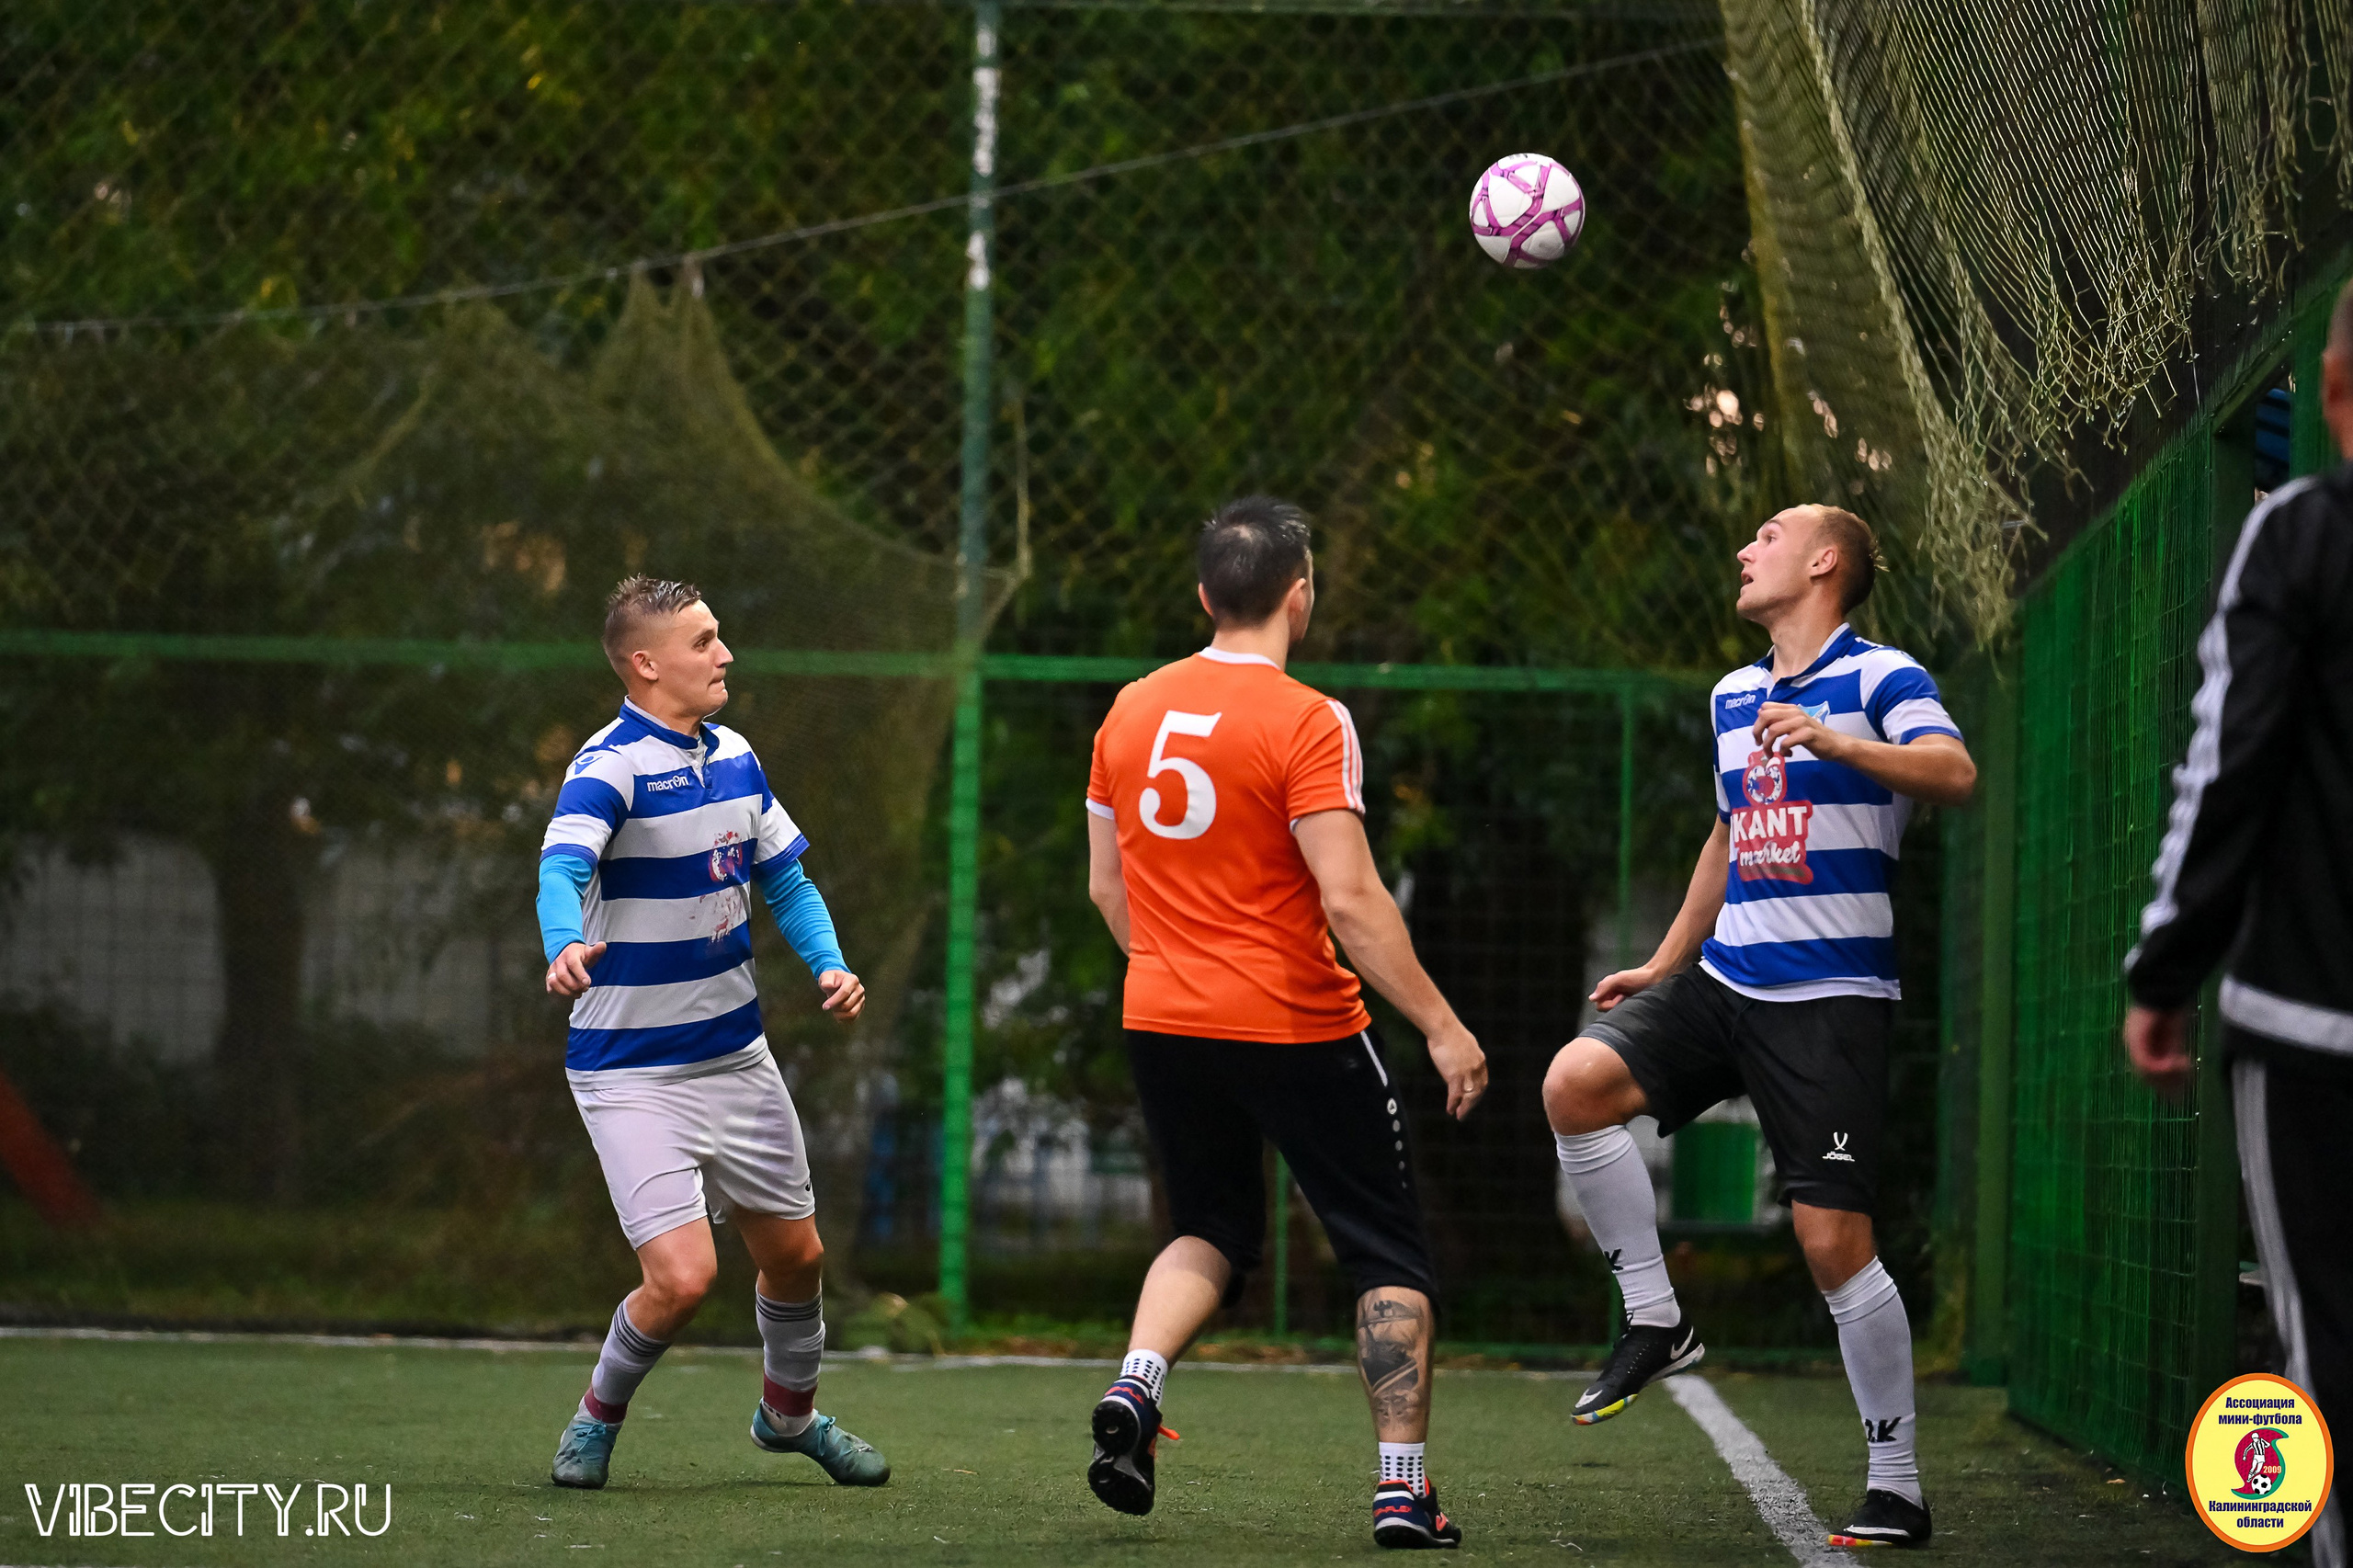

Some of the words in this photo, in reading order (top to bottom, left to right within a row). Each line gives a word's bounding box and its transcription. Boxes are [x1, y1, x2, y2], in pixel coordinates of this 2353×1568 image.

[1725, 694, 1756, 709] macron
[647, 775, 688, 791] macron
[1139, 710, 1222, 840] 5
[1733, 806, 1807, 843] KANT
[1740, 840, 1801, 866] market
